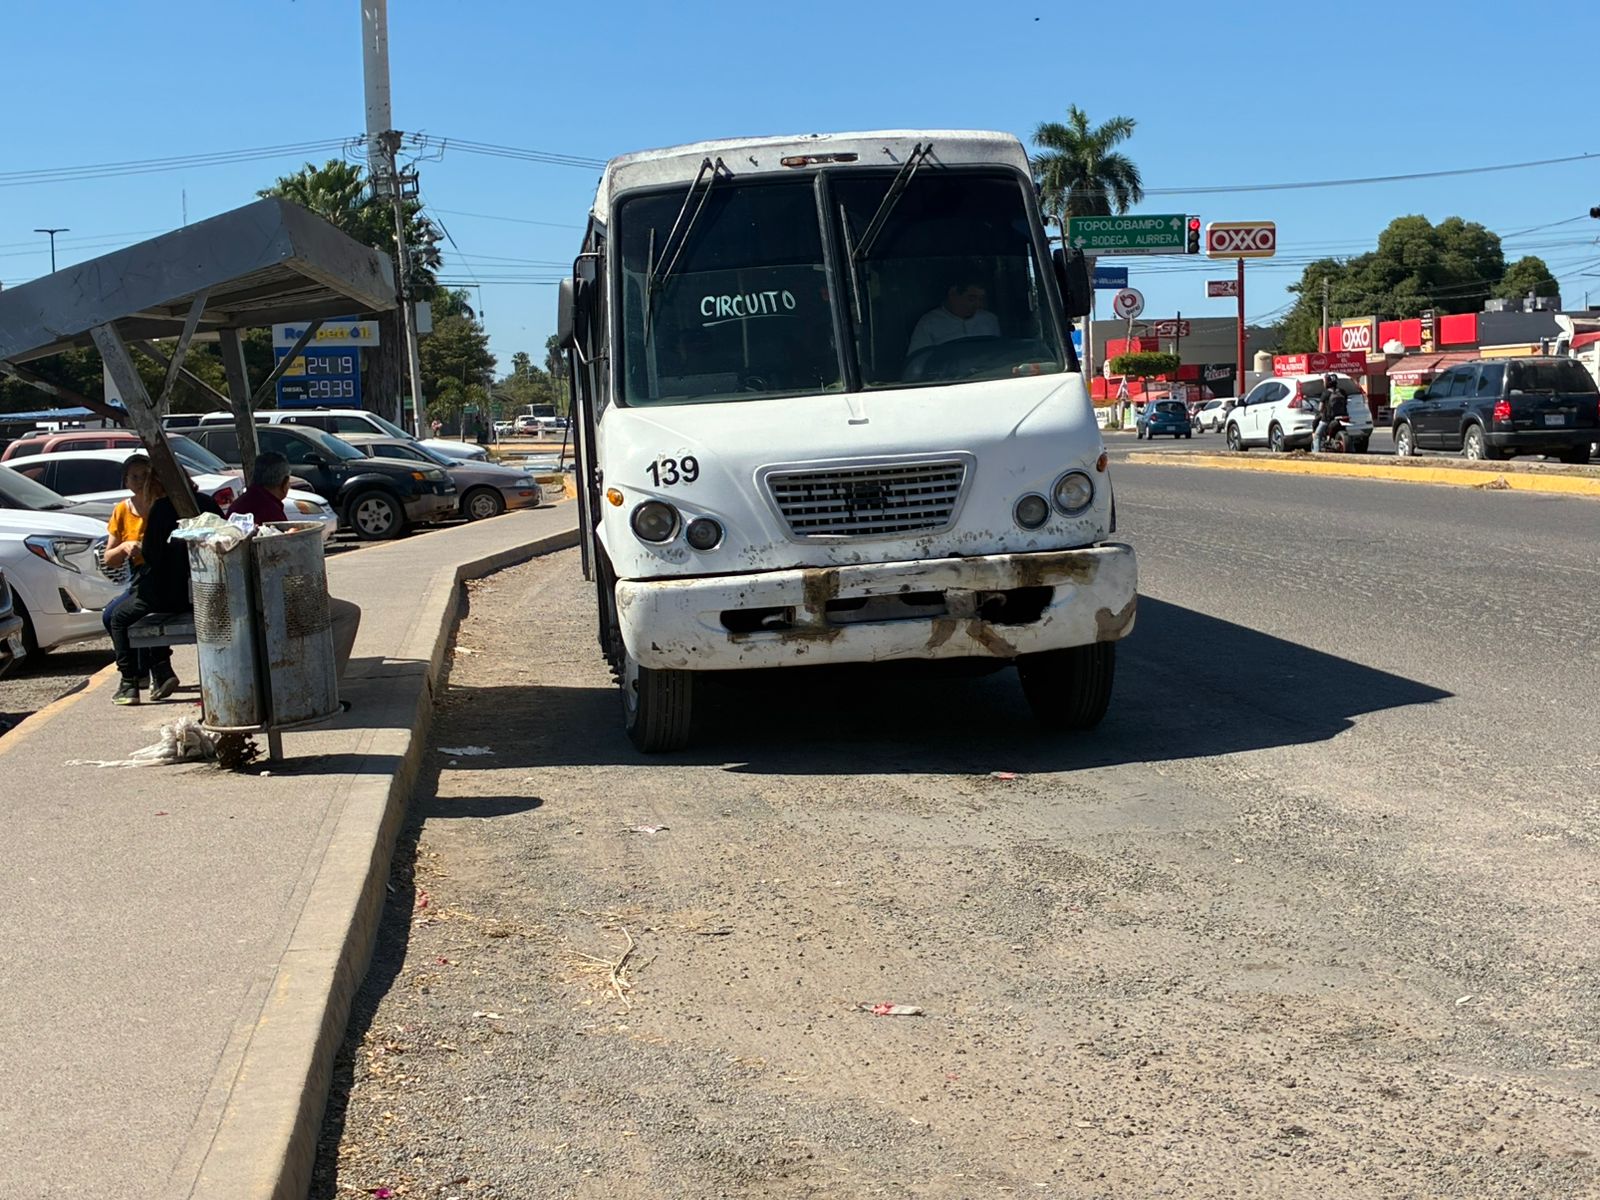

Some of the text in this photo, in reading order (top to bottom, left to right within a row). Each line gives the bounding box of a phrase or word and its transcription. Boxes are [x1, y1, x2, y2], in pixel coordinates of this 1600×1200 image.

[1076, 219, 1165, 231] TOPOLOBAMPO
[1091, 233, 1180, 246] BODEGA AURRERA
[1211, 228, 1273, 250] OXXO
[700, 289, 797, 318] CIRCUITO
[1342, 325, 1370, 350] OXXO
[645, 455, 700, 487] 139
